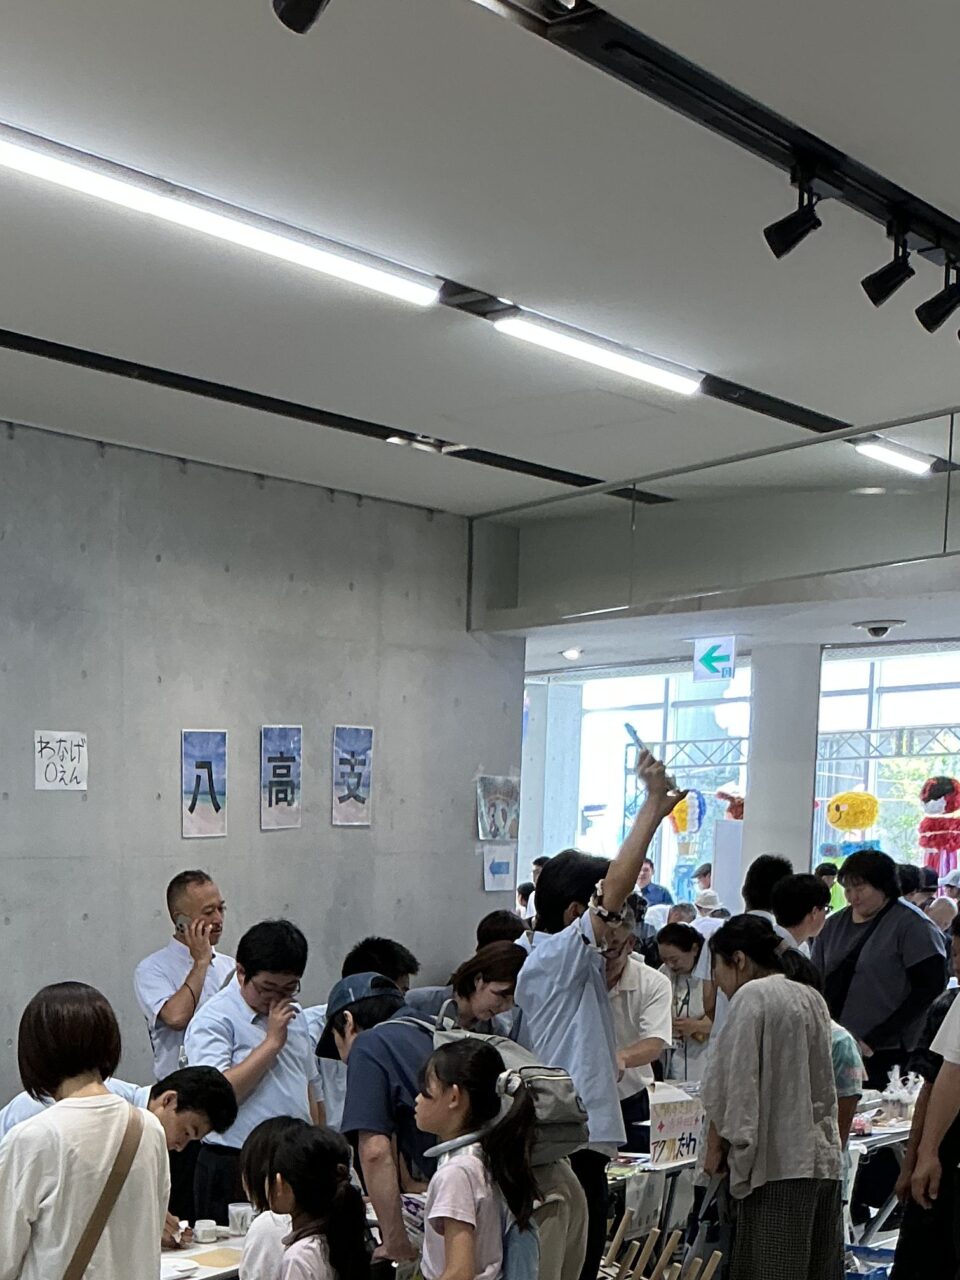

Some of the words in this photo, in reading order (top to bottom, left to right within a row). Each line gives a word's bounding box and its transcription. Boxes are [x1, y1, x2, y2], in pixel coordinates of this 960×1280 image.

[37, 736, 86, 764] わなげ
[188, 751, 366, 814] 八高支
